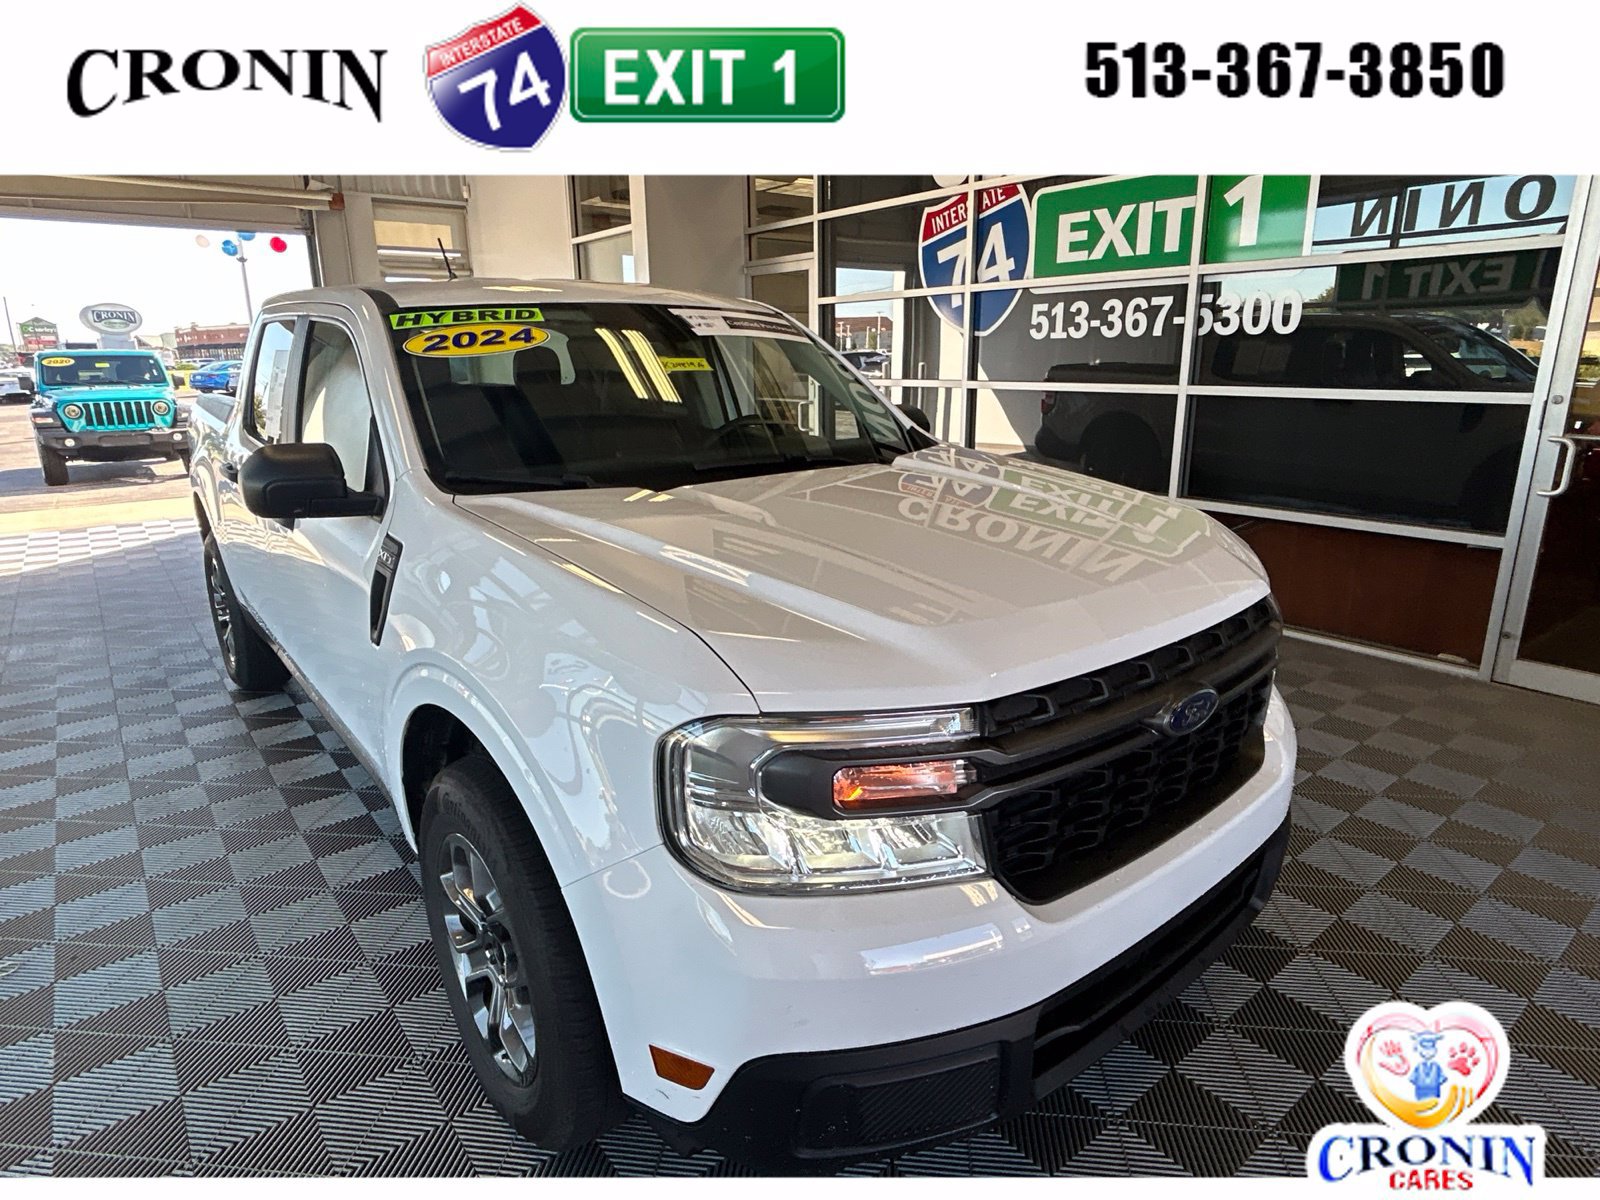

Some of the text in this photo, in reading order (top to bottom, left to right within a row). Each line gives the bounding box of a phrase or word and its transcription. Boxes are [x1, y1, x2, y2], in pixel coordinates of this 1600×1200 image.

[931, 187, 1007, 235] INTERATE
[1056, 174, 1265, 264] EXIT 1
[937, 221, 1016, 309] 74
[94, 311, 136, 322] CRONIN
[396, 308, 537, 328] HYBRID
[1029, 288, 1303, 341] 513-367-5300
[422, 327, 537, 353] 2024
